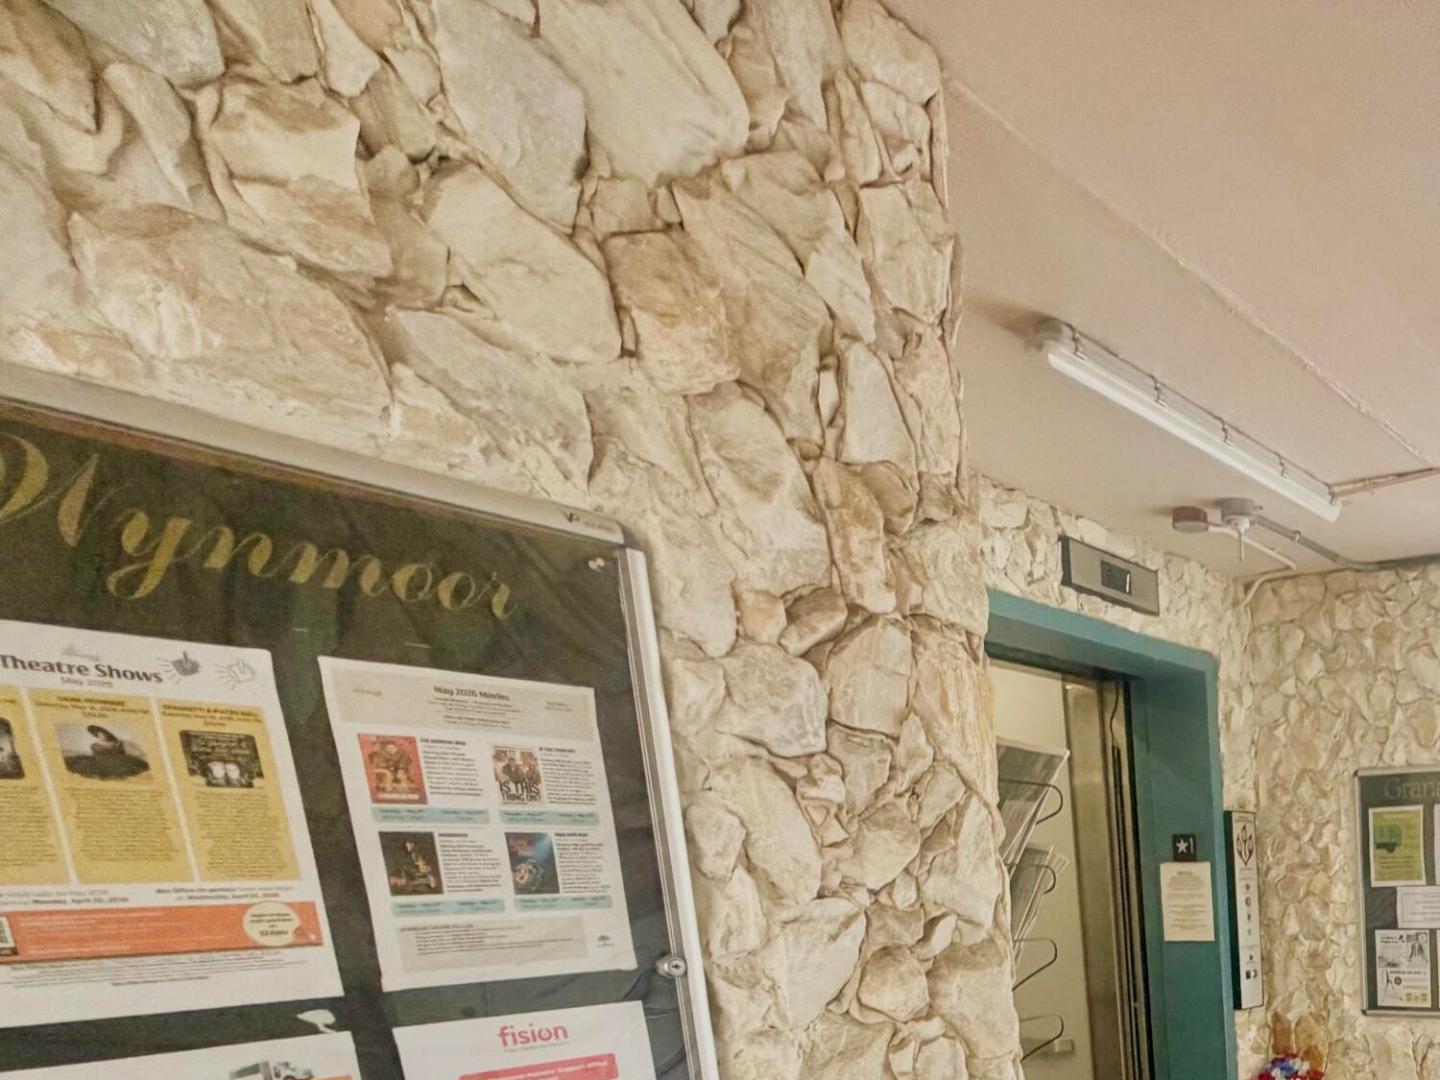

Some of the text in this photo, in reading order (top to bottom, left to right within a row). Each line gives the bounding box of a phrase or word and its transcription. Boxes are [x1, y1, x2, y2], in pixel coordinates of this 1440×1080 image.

[0, 654, 163, 683] Theatre Shows
[498, 1022, 569, 1048] fision
